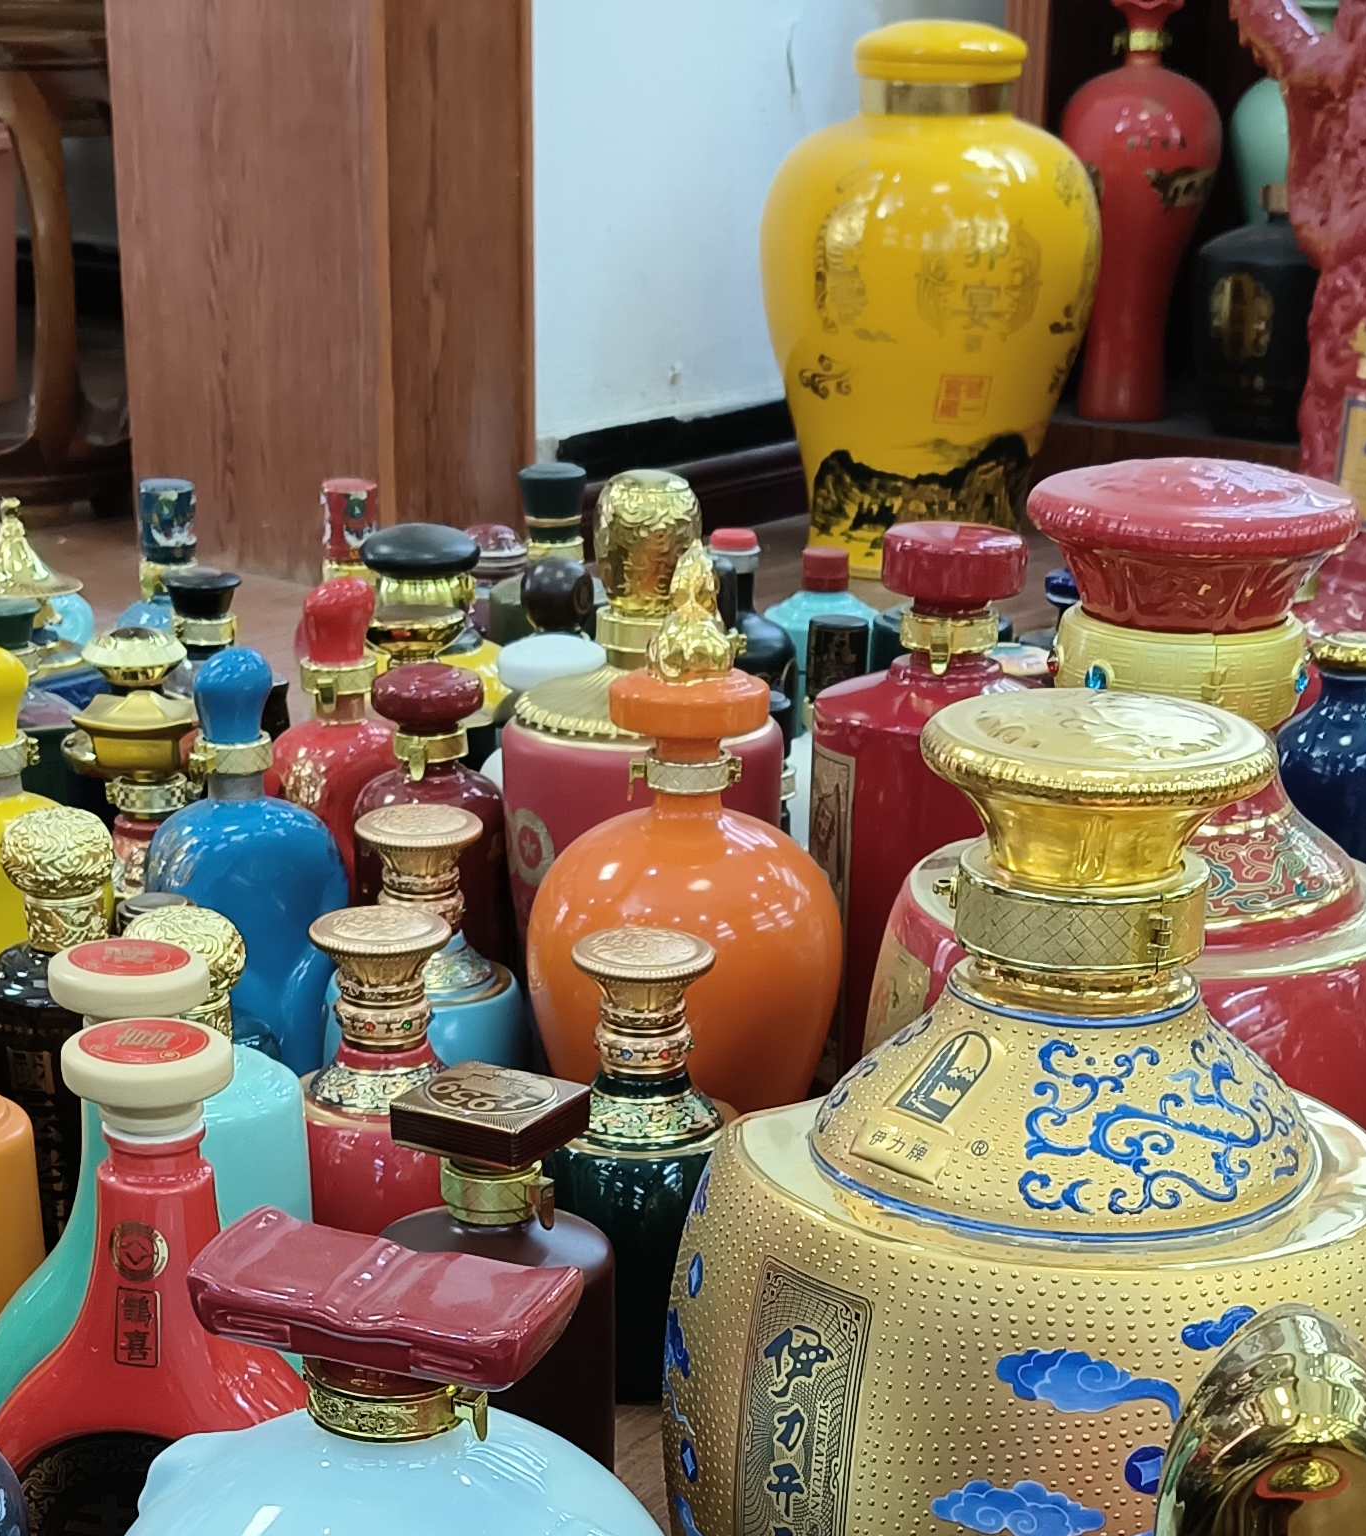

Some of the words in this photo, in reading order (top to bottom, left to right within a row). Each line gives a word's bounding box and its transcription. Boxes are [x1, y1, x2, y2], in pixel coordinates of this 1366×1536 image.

[430, 1081, 535, 1112] 1959
[869, 1129, 929, 1163] 伊力牌
